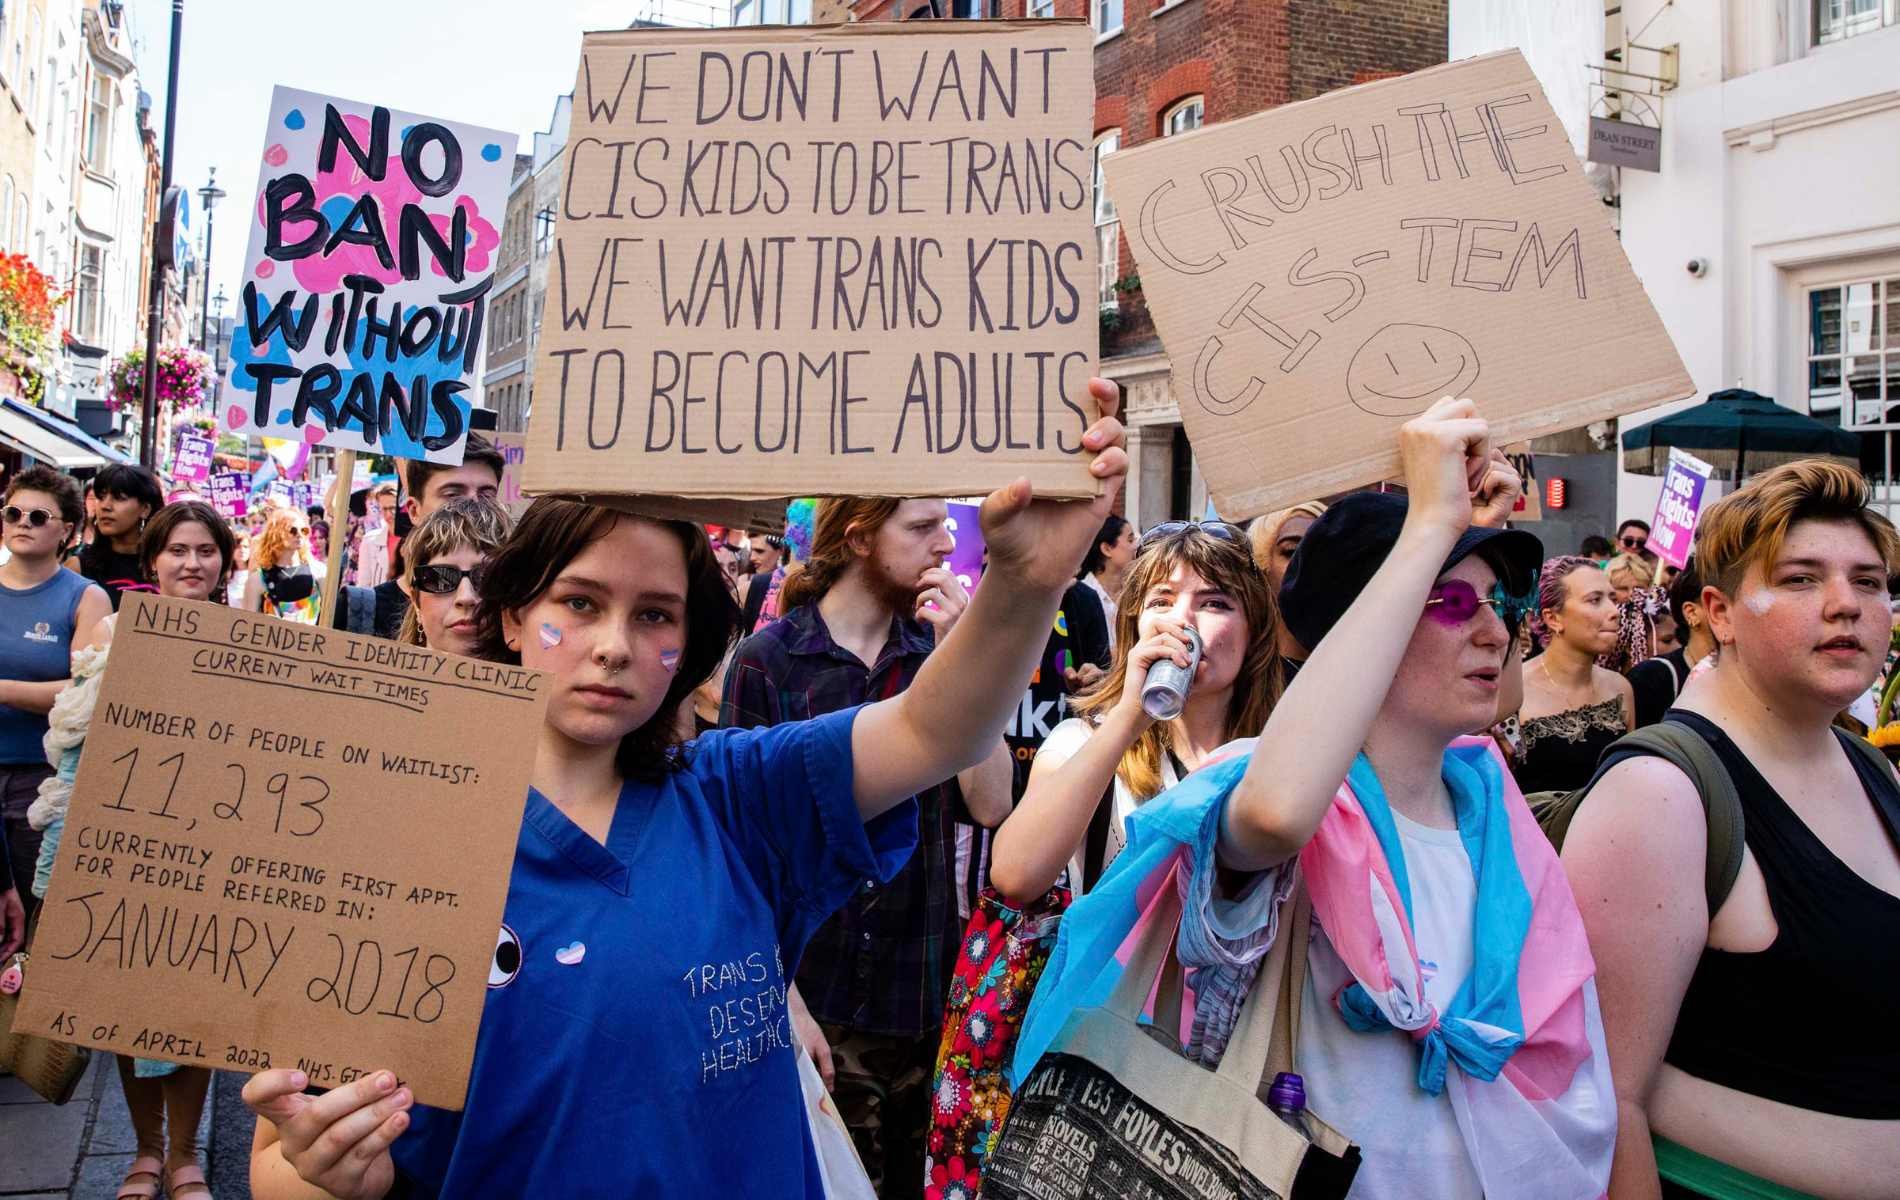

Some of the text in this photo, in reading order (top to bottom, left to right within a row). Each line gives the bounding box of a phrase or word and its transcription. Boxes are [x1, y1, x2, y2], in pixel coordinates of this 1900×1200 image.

[584, 47, 1067, 125] WE DON'T WANT
[318, 103, 463, 197] NO
[564, 137, 1084, 220] CIS KIDS TO BE TRANS
[1139, 94, 1567, 275] CRUSH THE
[264, 173, 466, 284] BAN
[558, 235, 1082, 333] WE WANT TRANS KIDS
[243, 272, 495, 374] WITHOUT
[245, 362, 471, 451] TRANS
[549, 348, 1088, 455] TO BECOME ADULTS
[211, 476, 236, 492] Trans
[213, 487, 244, 506] Rights
[1659, 488, 1696, 530] Rights
[1666, 462, 1695, 499] Trans
[1653, 514, 1676, 550] Now
[135, 602, 541, 692] NHS GENDER IDENTITY CLINIC
[193, 649, 430, 706] CURRENT WAIT TIMES
[105, 702, 480, 785] NUMBER OF PEOPLE ON WAITLIST:
[75, 854, 375, 921] FOR PEOPLE REFERRED IN:
[78, 826, 460, 907] CURRENTLY OFFERING FIRST APPT.
[51, 891, 456, 1024] JANUARY 2018
[683, 952, 767, 999] TRANS
[51, 1011, 77, 1036] AS
[92, 1025, 119, 1041] OF
[133, 1028, 206, 1058] APRIL
[226, 1045, 271, 1069] 2022
[702, 1015, 793, 1085] HEALTHC
[1043, 1114, 1098, 1162] NOVELS
[1052, 1143, 1091, 1180] EACH
[1113, 1101, 1187, 1175] FOYLE'S
